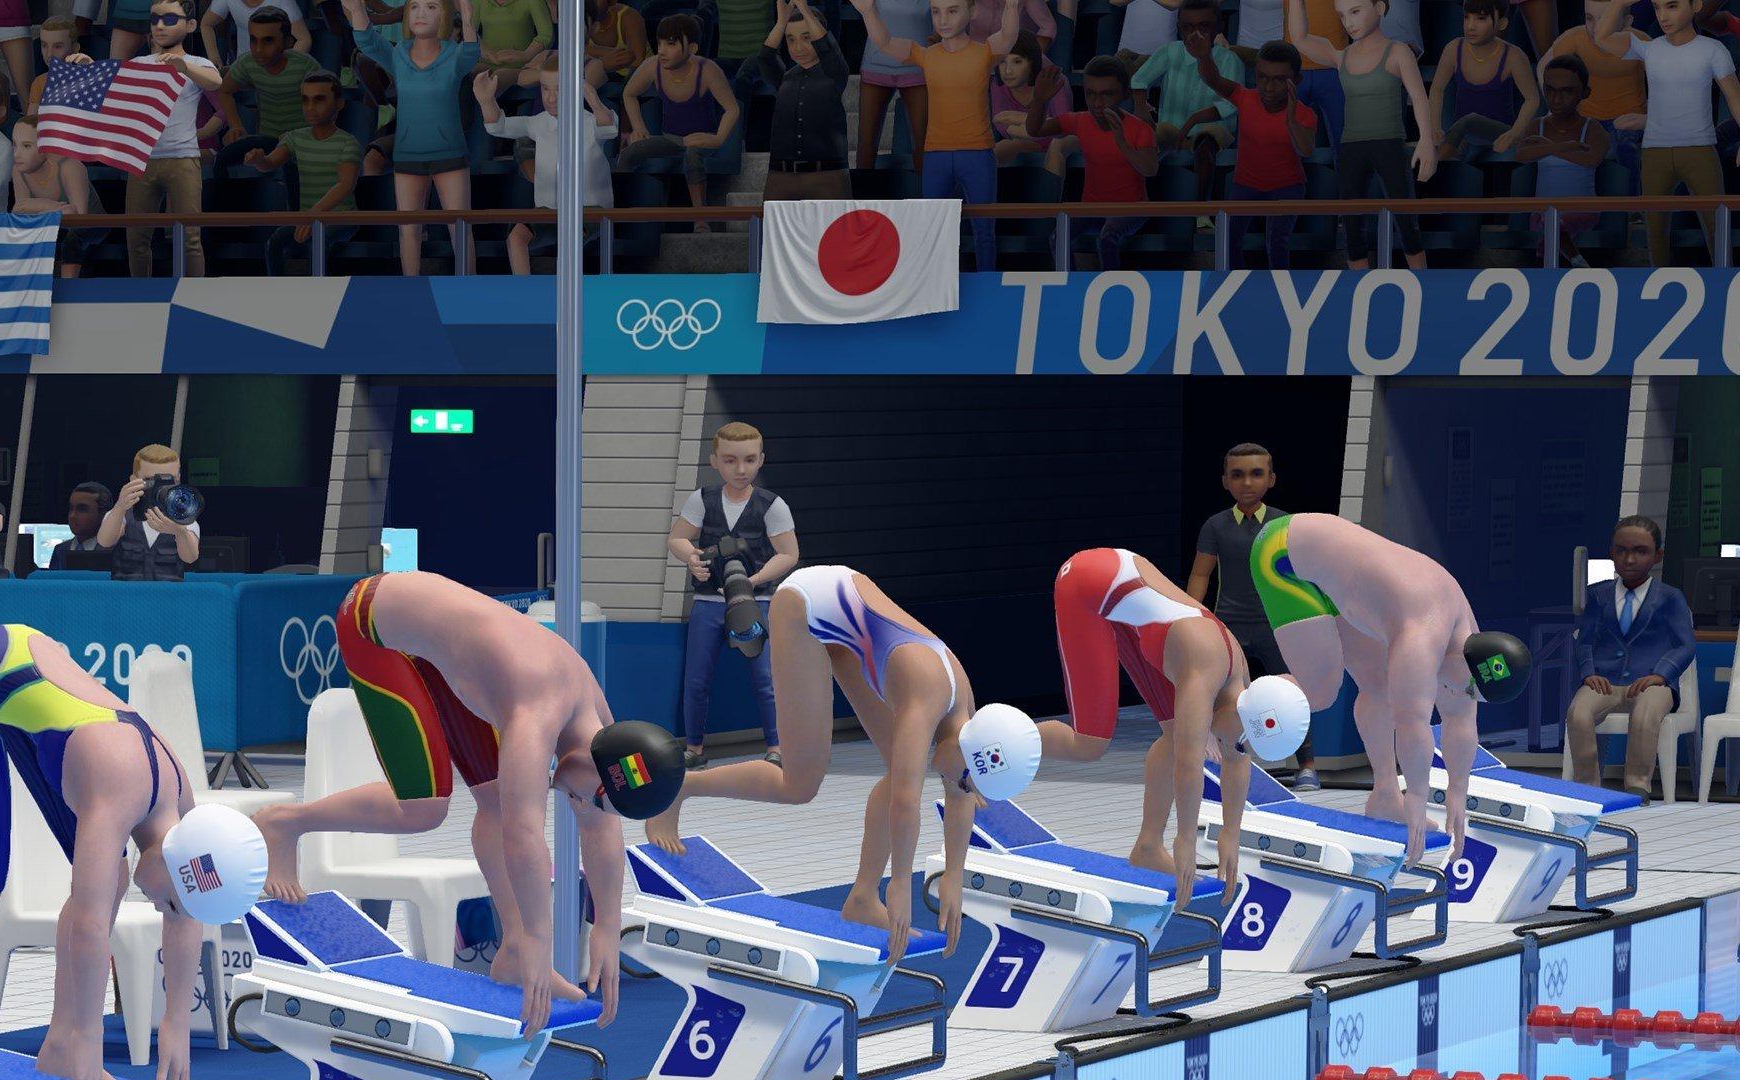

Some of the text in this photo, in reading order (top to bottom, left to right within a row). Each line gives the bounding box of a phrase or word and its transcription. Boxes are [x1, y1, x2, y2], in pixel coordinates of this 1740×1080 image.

[1001, 269, 1423, 376] TOKYO
[971, 751, 989, 776] KOR
[178, 864, 197, 894] USA
[1452, 858, 1475, 891] 9
[1531, 857, 1562, 902] 9
[1241, 902, 1265, 938] 8
[1330, 901, 1364, 949] 8
[999, 956, 1024, 993] 7
[1091, 952, 1134, 1005] 7
[689, 1020, 716, 1060] 6
[803, 1016, 843, 1073] 6
